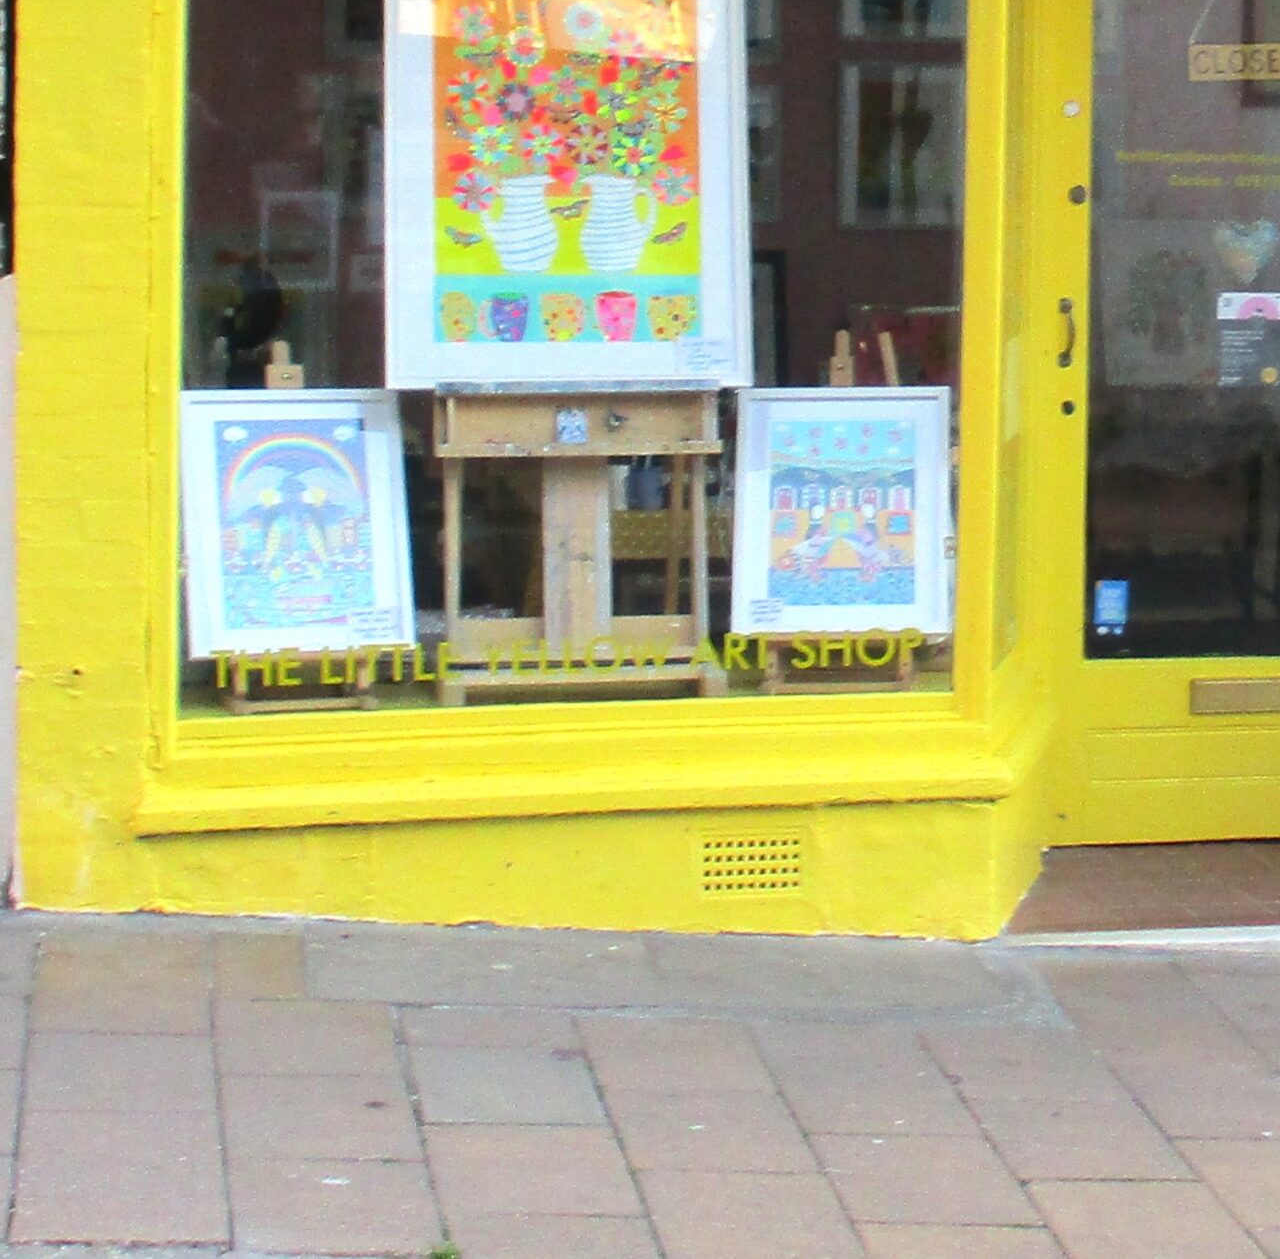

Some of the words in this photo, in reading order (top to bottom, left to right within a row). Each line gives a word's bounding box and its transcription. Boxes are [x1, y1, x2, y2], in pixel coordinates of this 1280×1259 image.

[210, 647, 303, 688] THE
[320, 642, 462, 685] LITTLE
[485, 634, 676, 678] YELLOW
[688, 631, 774, 671] ART
[788, 626, 926, 670] SHOP
